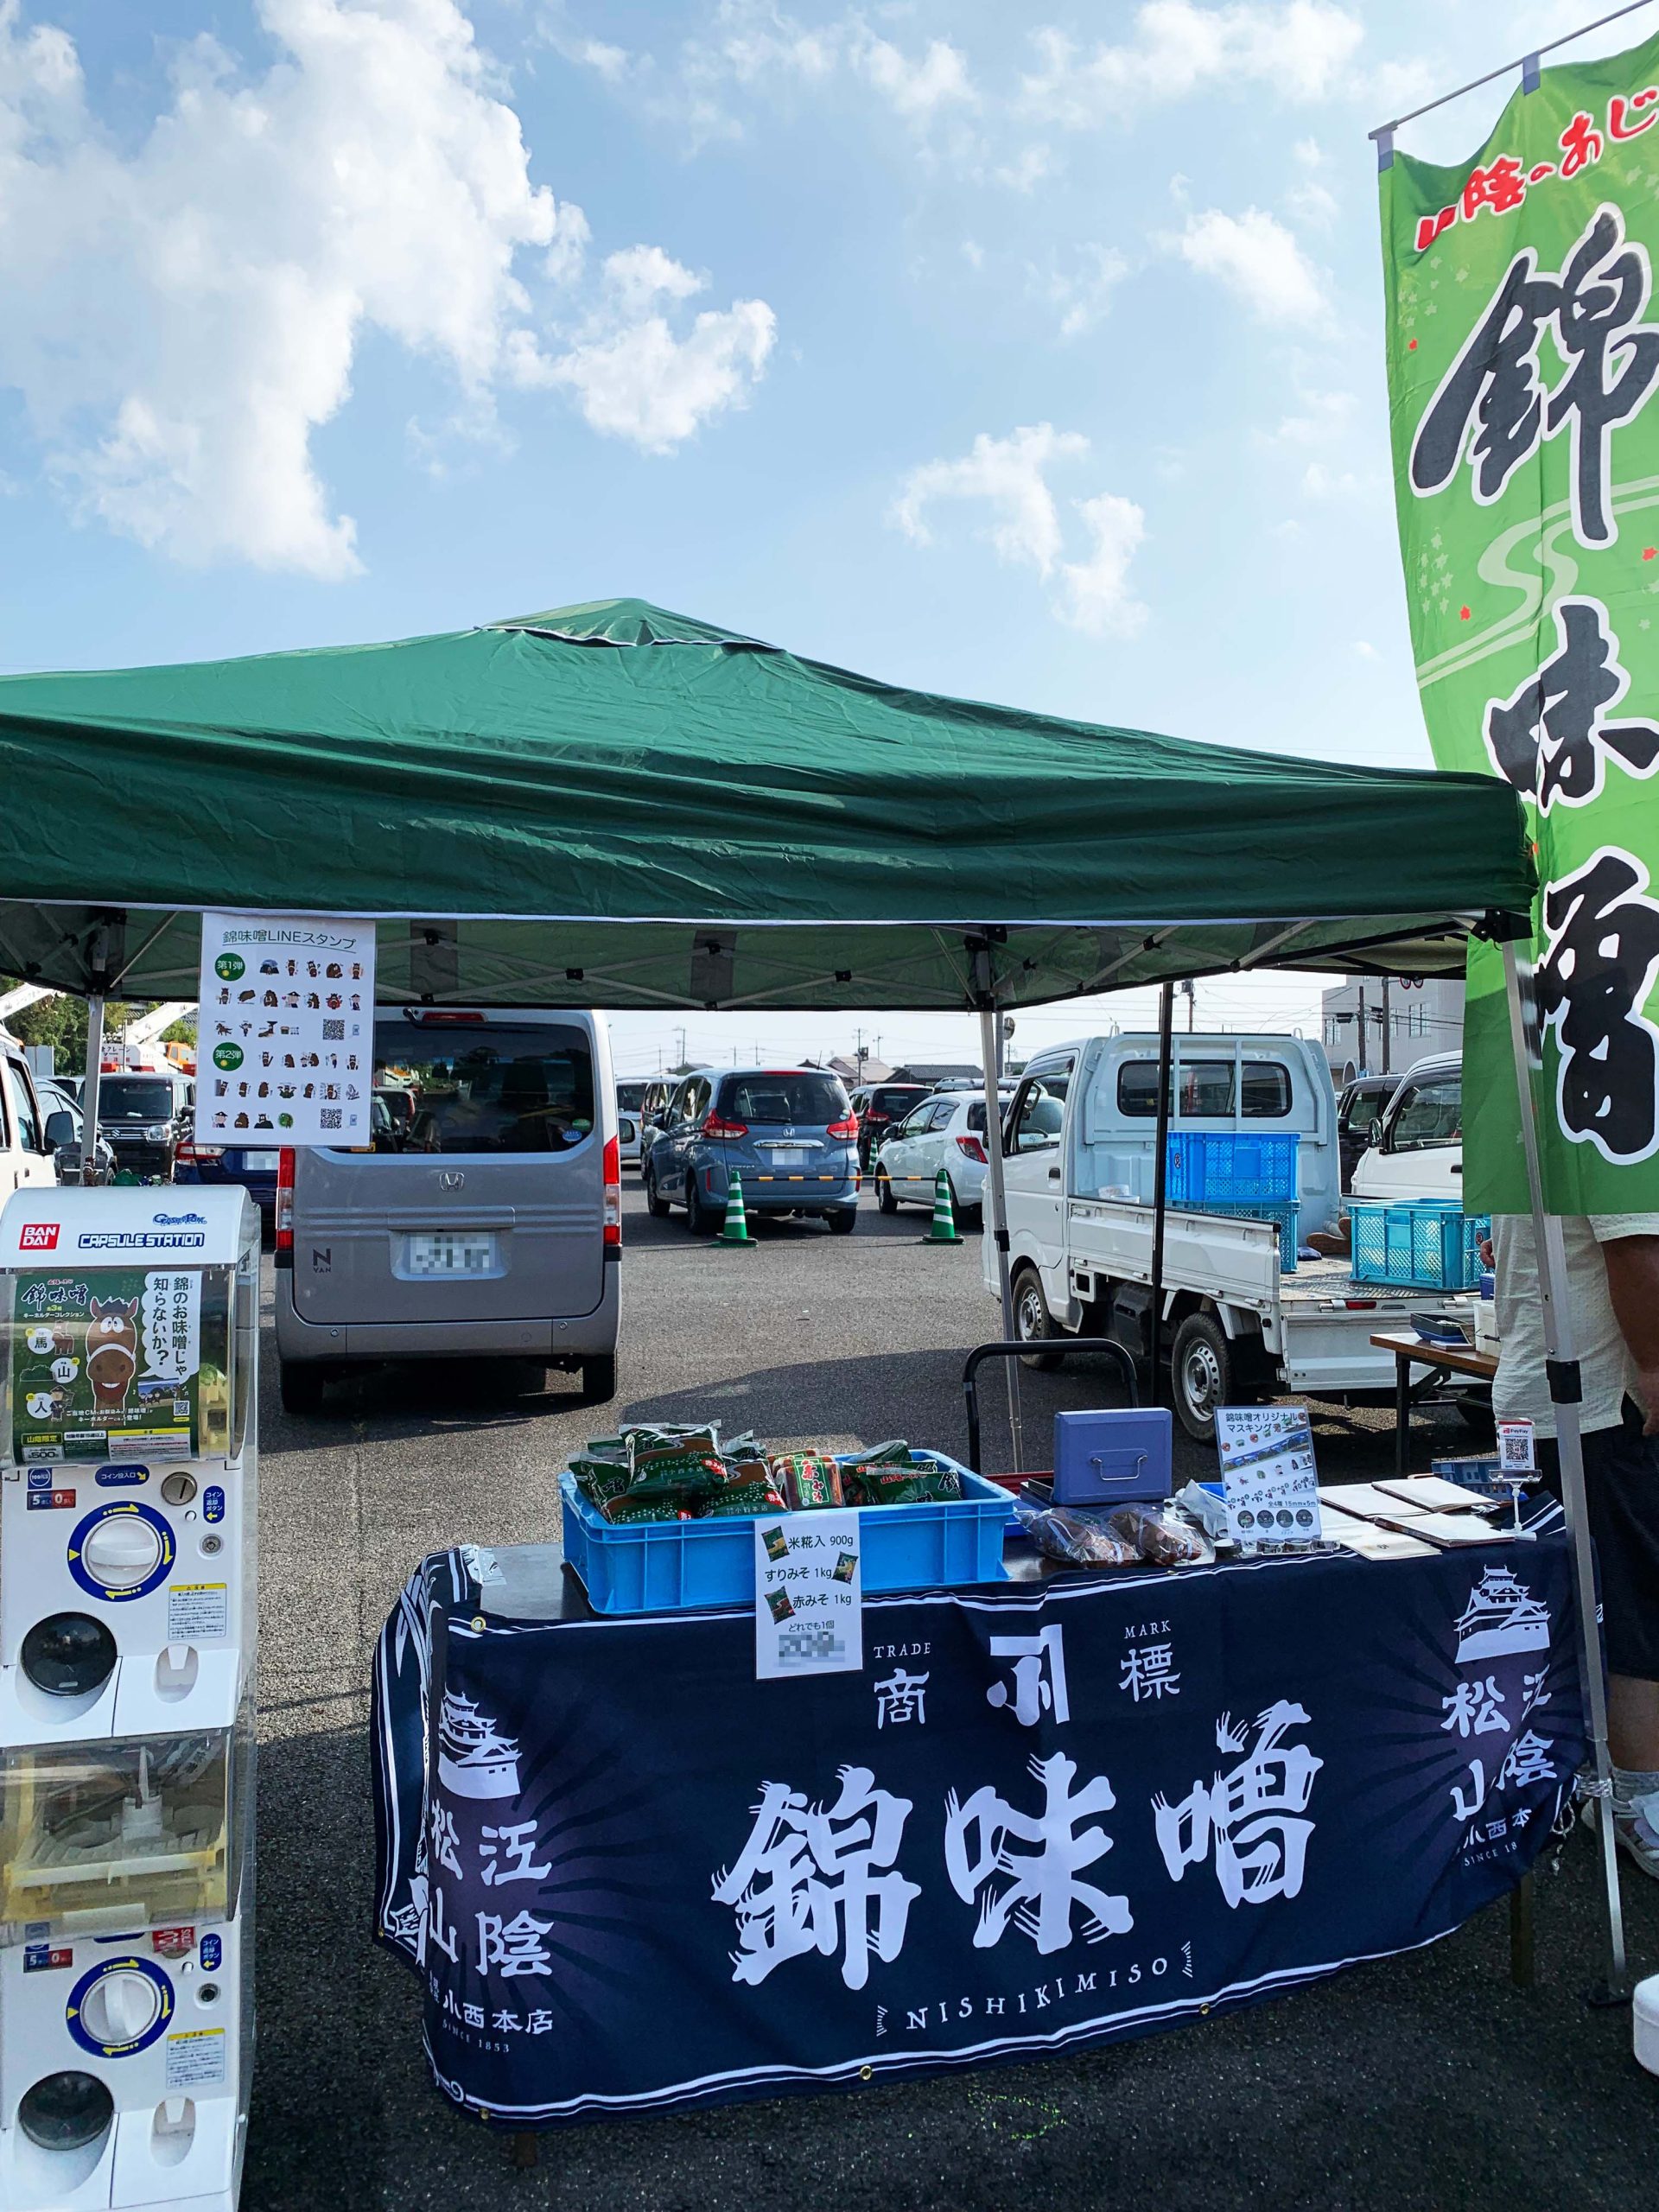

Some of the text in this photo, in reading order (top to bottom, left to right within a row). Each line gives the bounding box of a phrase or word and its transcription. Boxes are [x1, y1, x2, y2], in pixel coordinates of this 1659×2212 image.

[222, 929, 357, 950] 錦味噌LINEスタンプ
[216, 959, 243, 970] 第1弾
[215, 1048, 242, 1060] 第2弾
[24, 1225, 57, 1236] BAN
[22, 1236, 48, 1246] DAI
[172, 1277, 189, 1376] 錦のお味噌じゃ
[35, 1336, 48, 1349] 馬
[58, 1365, 70, 1378] 山
[35, 1401, 48, 1414] 人
[1225, 1412, 1298, 1424] 錦味噌オリジナル
[101, 1471, 137, 1480] コイン投入口
[801, 1464, 825, 1503] 赤みそ
[788, 1535, 854, 1550] 米糀入 900g
[765, 1567, 832, 1583] すりみそ 1kg
[792, 1593, 852, 1609] 赤みそ 1kg
[788, 1620, 835, 1632] どれでも1個
[873, 1619, 1172, 1659] TRADE MARK
[873, 1642, 1181, 1730] 商 標
[431, 1797, 553, 1887] 松江
[710, 1699, 1325, 1991] 錦味噌
[906, 1955, 1170, 2031] NISHIKIMISO
[442, 1989, 554, 2035] 小西本店
[478, 2038, 511, 2054] 1853
